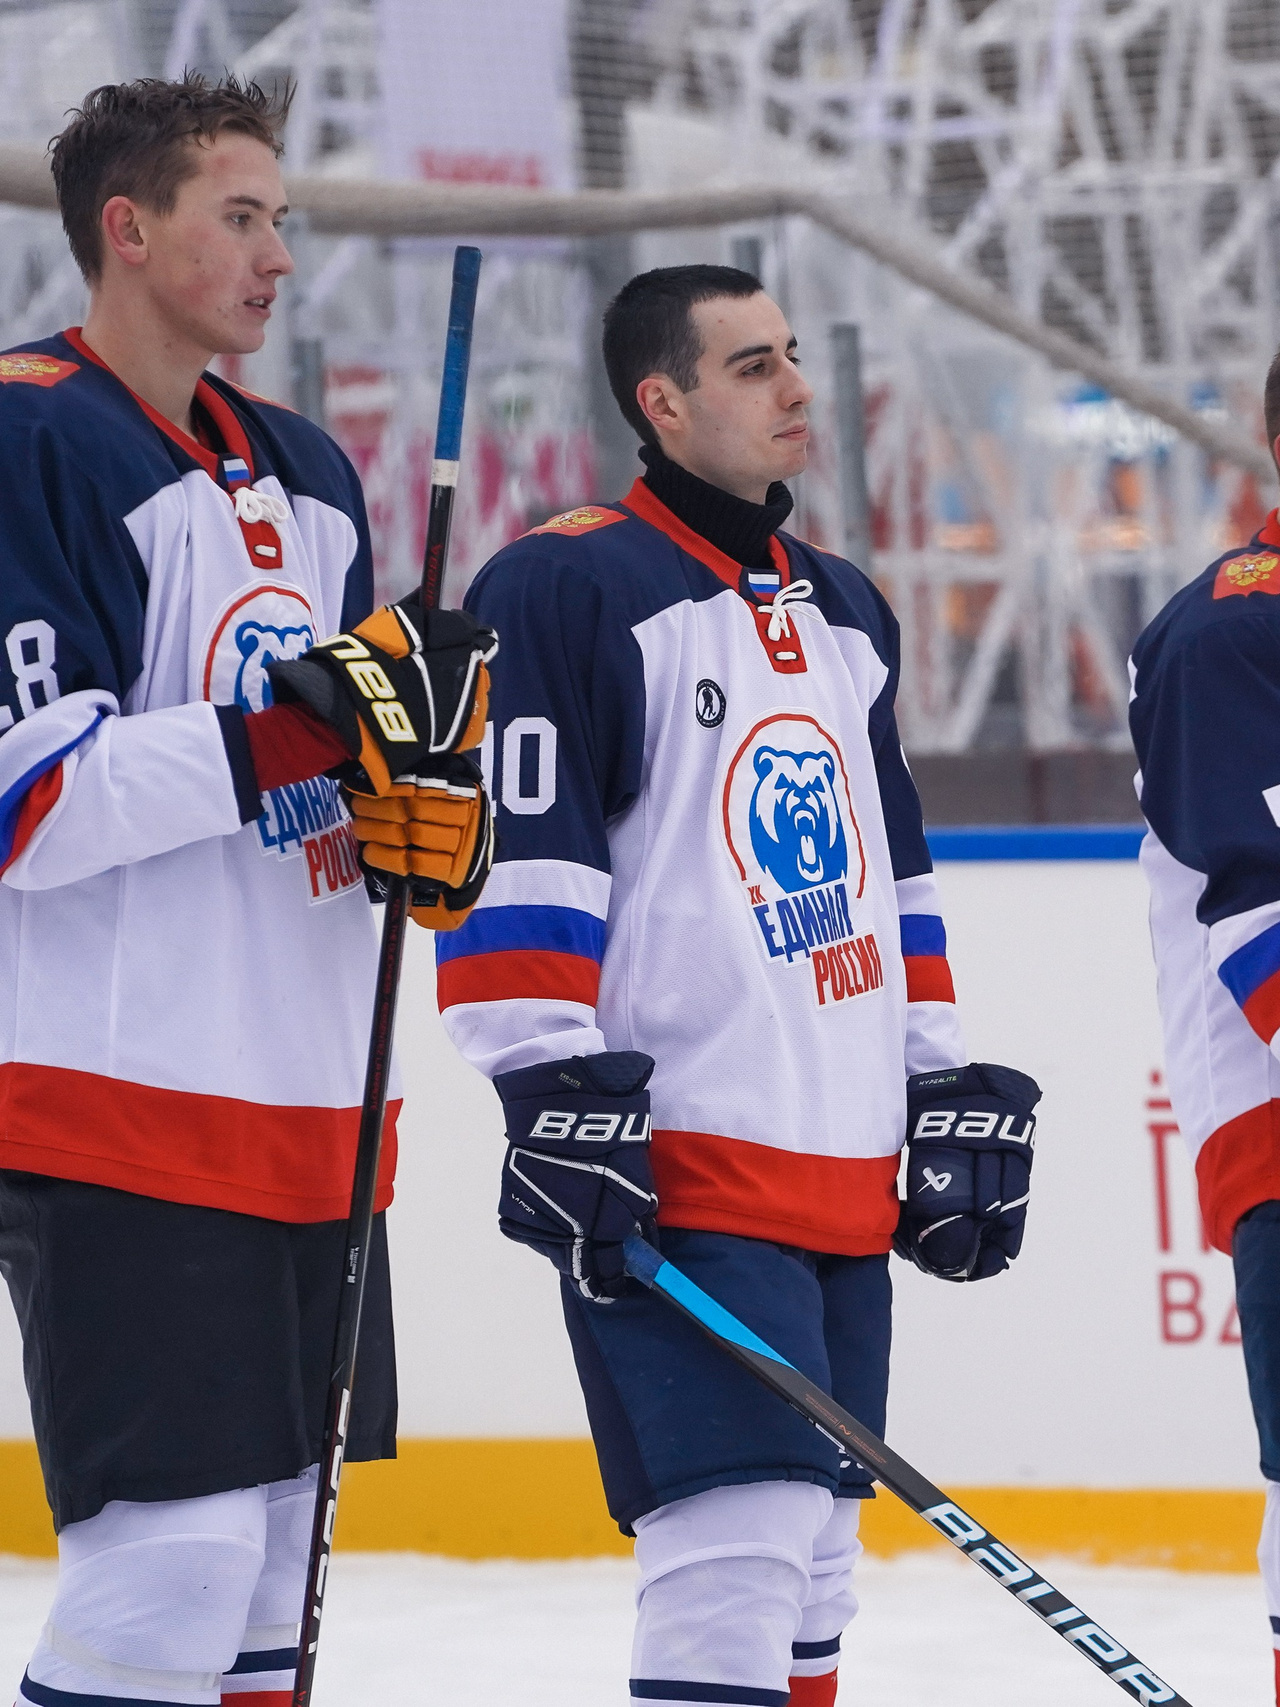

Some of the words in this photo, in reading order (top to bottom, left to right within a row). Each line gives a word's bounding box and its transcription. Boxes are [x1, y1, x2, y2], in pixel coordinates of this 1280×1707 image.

[0, 619, 61, 729] 8
[747, 885, 767, 905] ХК
[752, 883, 855, 963] ЕДИНАЯ
[811, 933, 884, 1006] РОССИЯ
[529, 1111, 653, 1142] BAU
